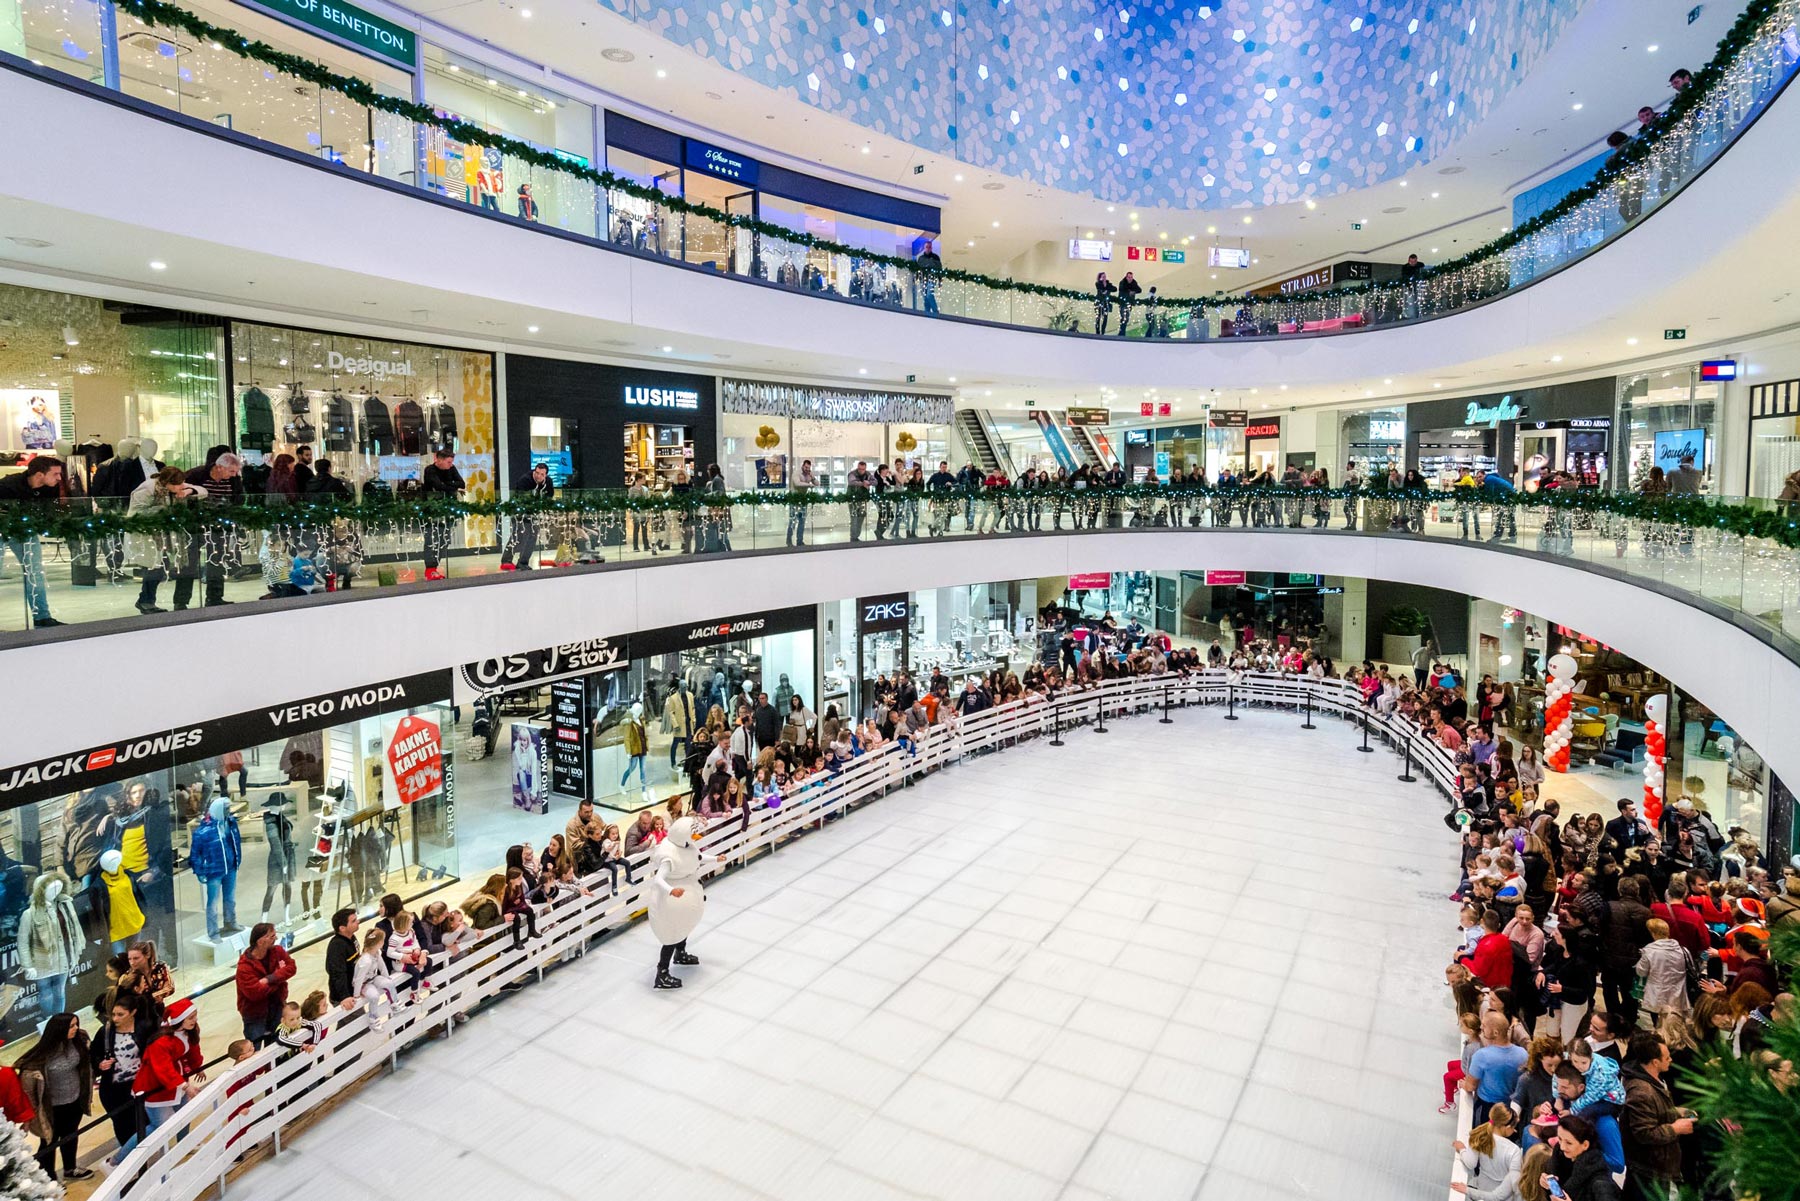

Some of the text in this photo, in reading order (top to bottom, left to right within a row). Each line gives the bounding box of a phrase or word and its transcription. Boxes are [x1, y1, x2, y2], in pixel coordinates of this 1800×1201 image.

[1280, 273, 1320, 295] STRADA
[625, 386, 675, 407] LUSH
[825, 398, 879, 414] SWAROVSKI
[1465, 395, 1520, 428] Douglas
[1244, 425, 1279, 436] GRACIJA
[1660, 440, 1699, 460] Douglas
[865, 602, 906, 622] ZAKS
[688, 619, 765, 640] JACK JONES
[568, 647, 618, 668] story
[269, 683, 406, 727] VERO MODA
[394, 727, 431, 758] JAKNE
[555, 741, 581, 751] SELECTED
[0, 729, 203, 791] JACK JONES
[394, 740, 439, 776] KAPUTI
[558, 753, 578, 763] VILA
[400, 762, 440, 795] -20%
[445, 763, 455, 839] VERO MODA
